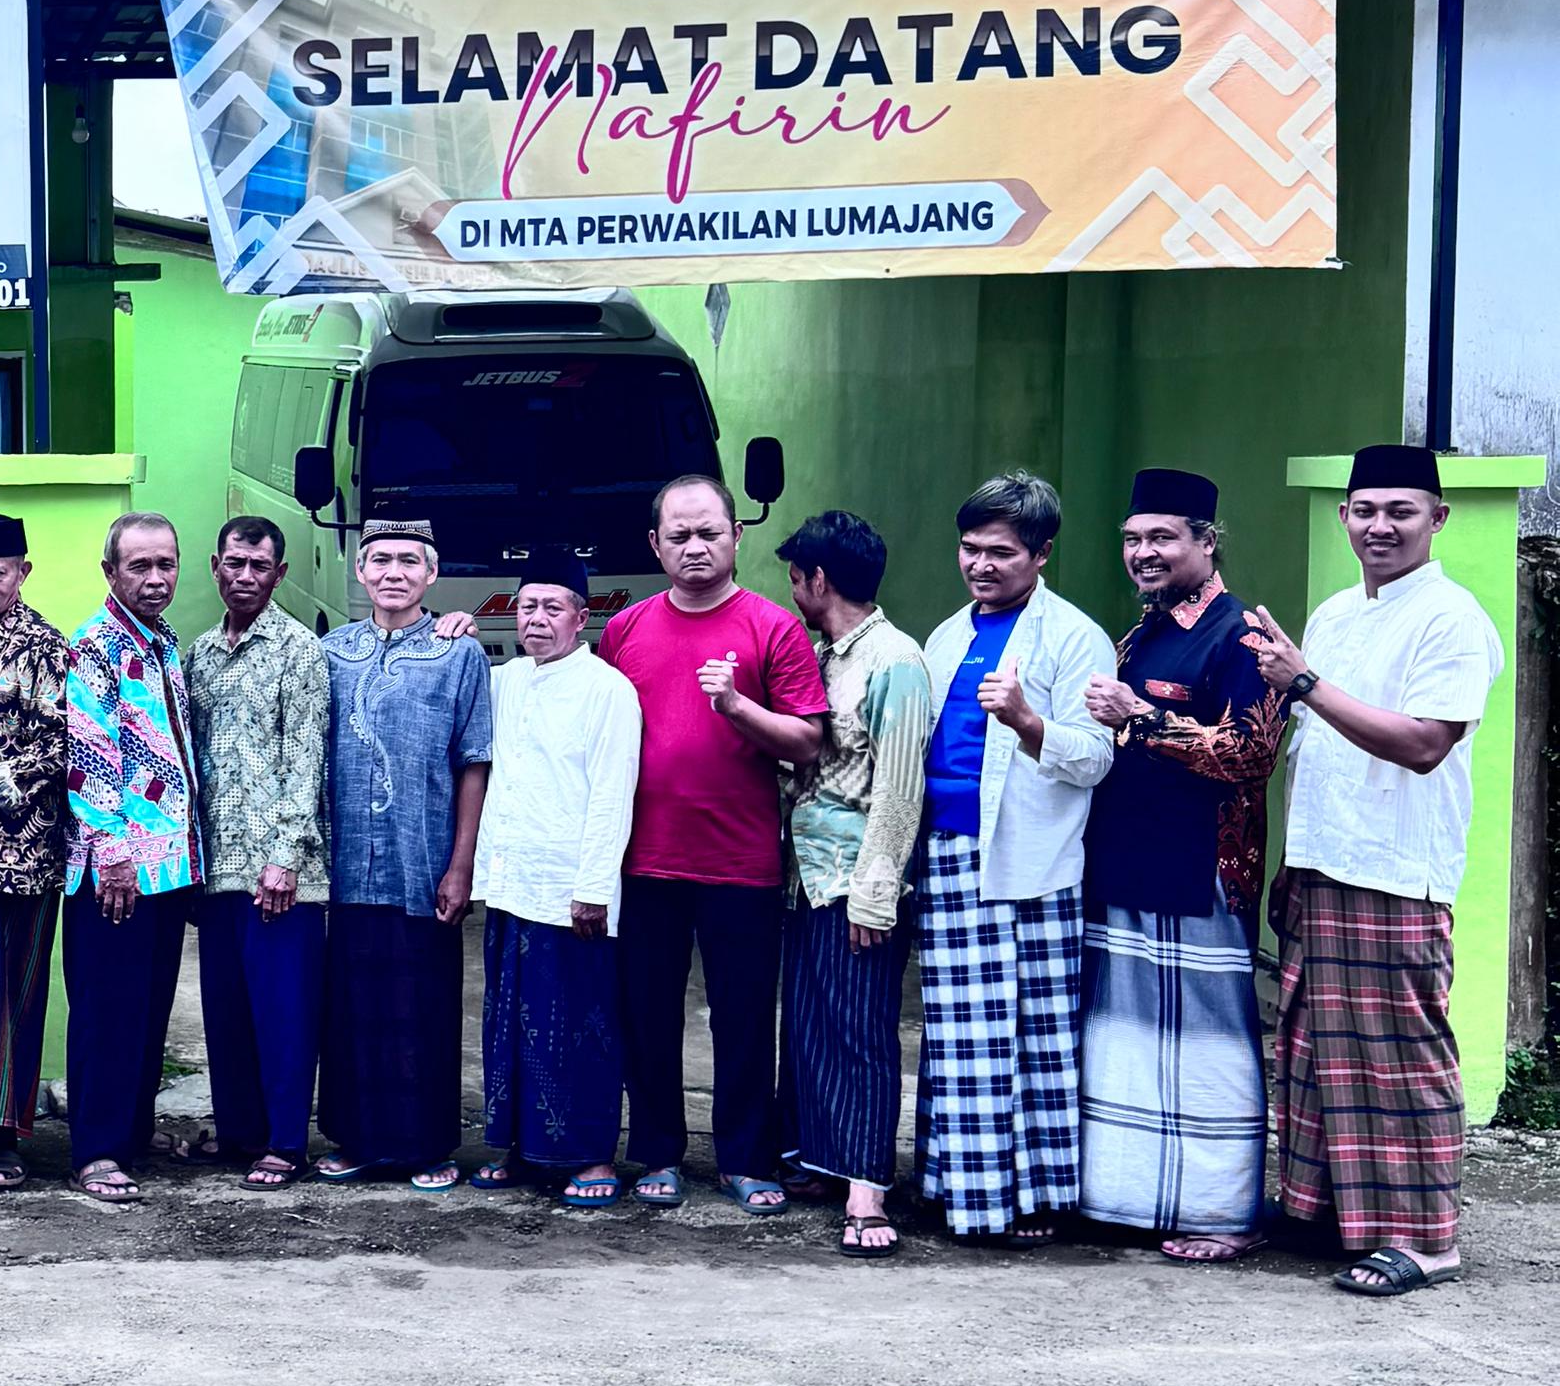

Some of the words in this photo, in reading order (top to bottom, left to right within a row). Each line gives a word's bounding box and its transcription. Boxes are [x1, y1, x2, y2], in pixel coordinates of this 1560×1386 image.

[291, 23, 728, 107] SELAMAT
[753, 4, 1182, 91] DATANG
[501, 44, 952, 204] Nafirin
[460, 220, 490, 249] DI
[500, 216, 568, 248] MTA
[577, 209, 799, 245] PERWAKILAN
[807, 200, 995, 237] LUMAJANG
